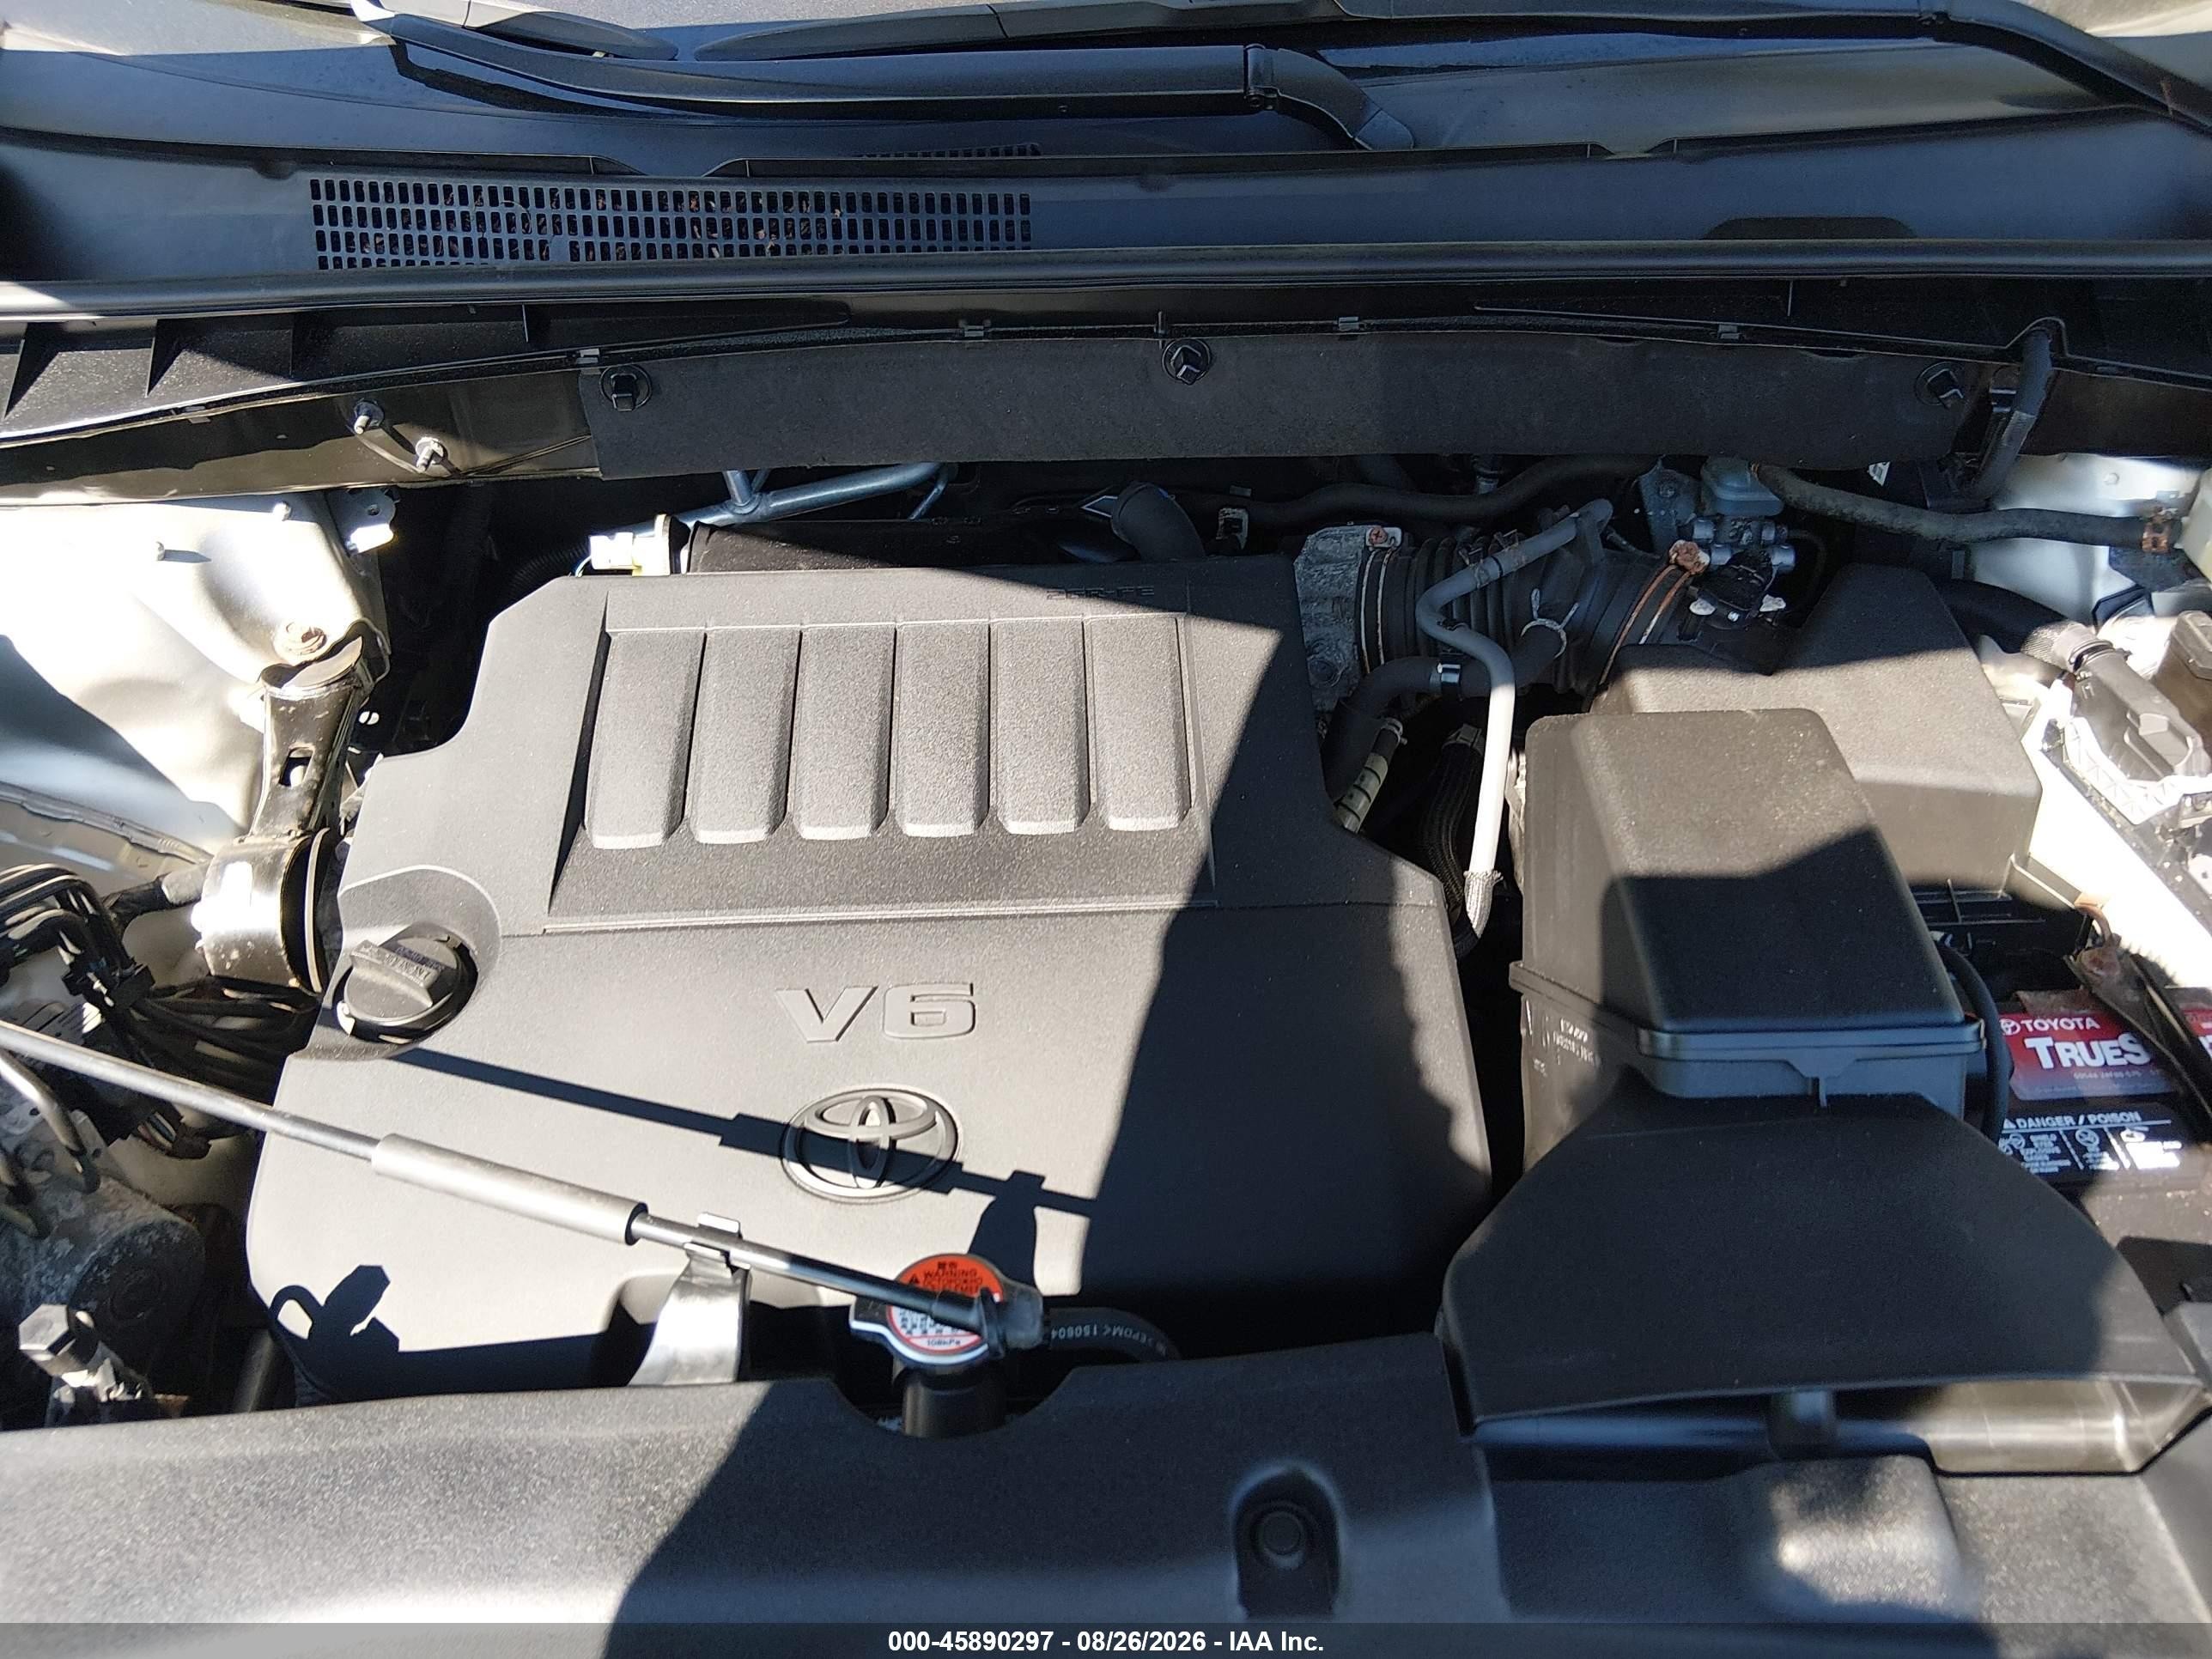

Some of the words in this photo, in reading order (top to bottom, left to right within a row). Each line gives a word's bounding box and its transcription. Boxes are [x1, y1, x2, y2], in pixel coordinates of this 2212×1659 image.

[775, 982, 976, 1043] V6
[2020, 1017, 2100, 1032] TOYOTA
[2016, 1115, 2076, 1128] DANGER
[2088, 1111, 2142, 1124] POISON
